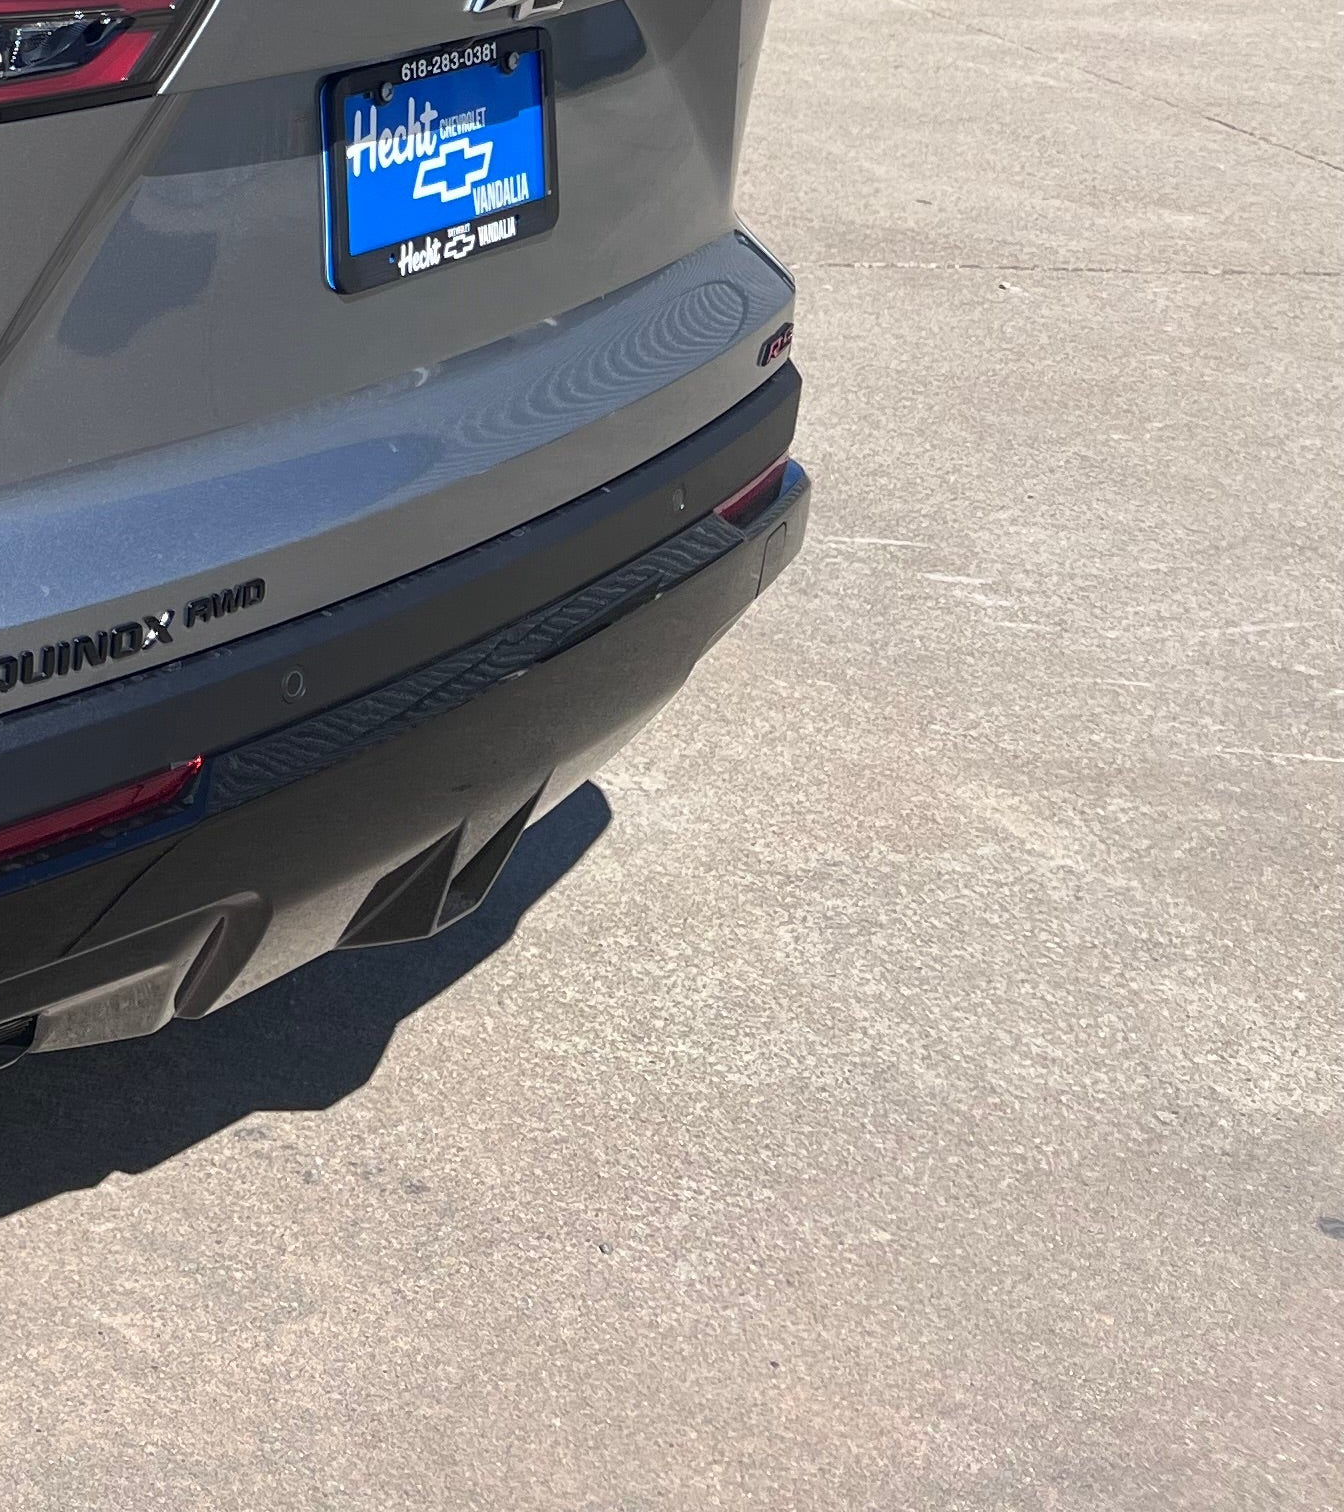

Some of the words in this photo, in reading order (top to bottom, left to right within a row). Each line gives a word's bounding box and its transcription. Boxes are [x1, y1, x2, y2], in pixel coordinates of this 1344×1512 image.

[401, 41, 498, 81] 618-283-0381
[346, 96, 439, 178] Hecht
[439, 106, 487, 141] CHEVROLET
[472, 172, 530, 216] VANDALIA
[398, 236, 441, 277] Hecht
[477, 215, 517, 247] VANDALIA
[183, 577, 267, 629] AWD
